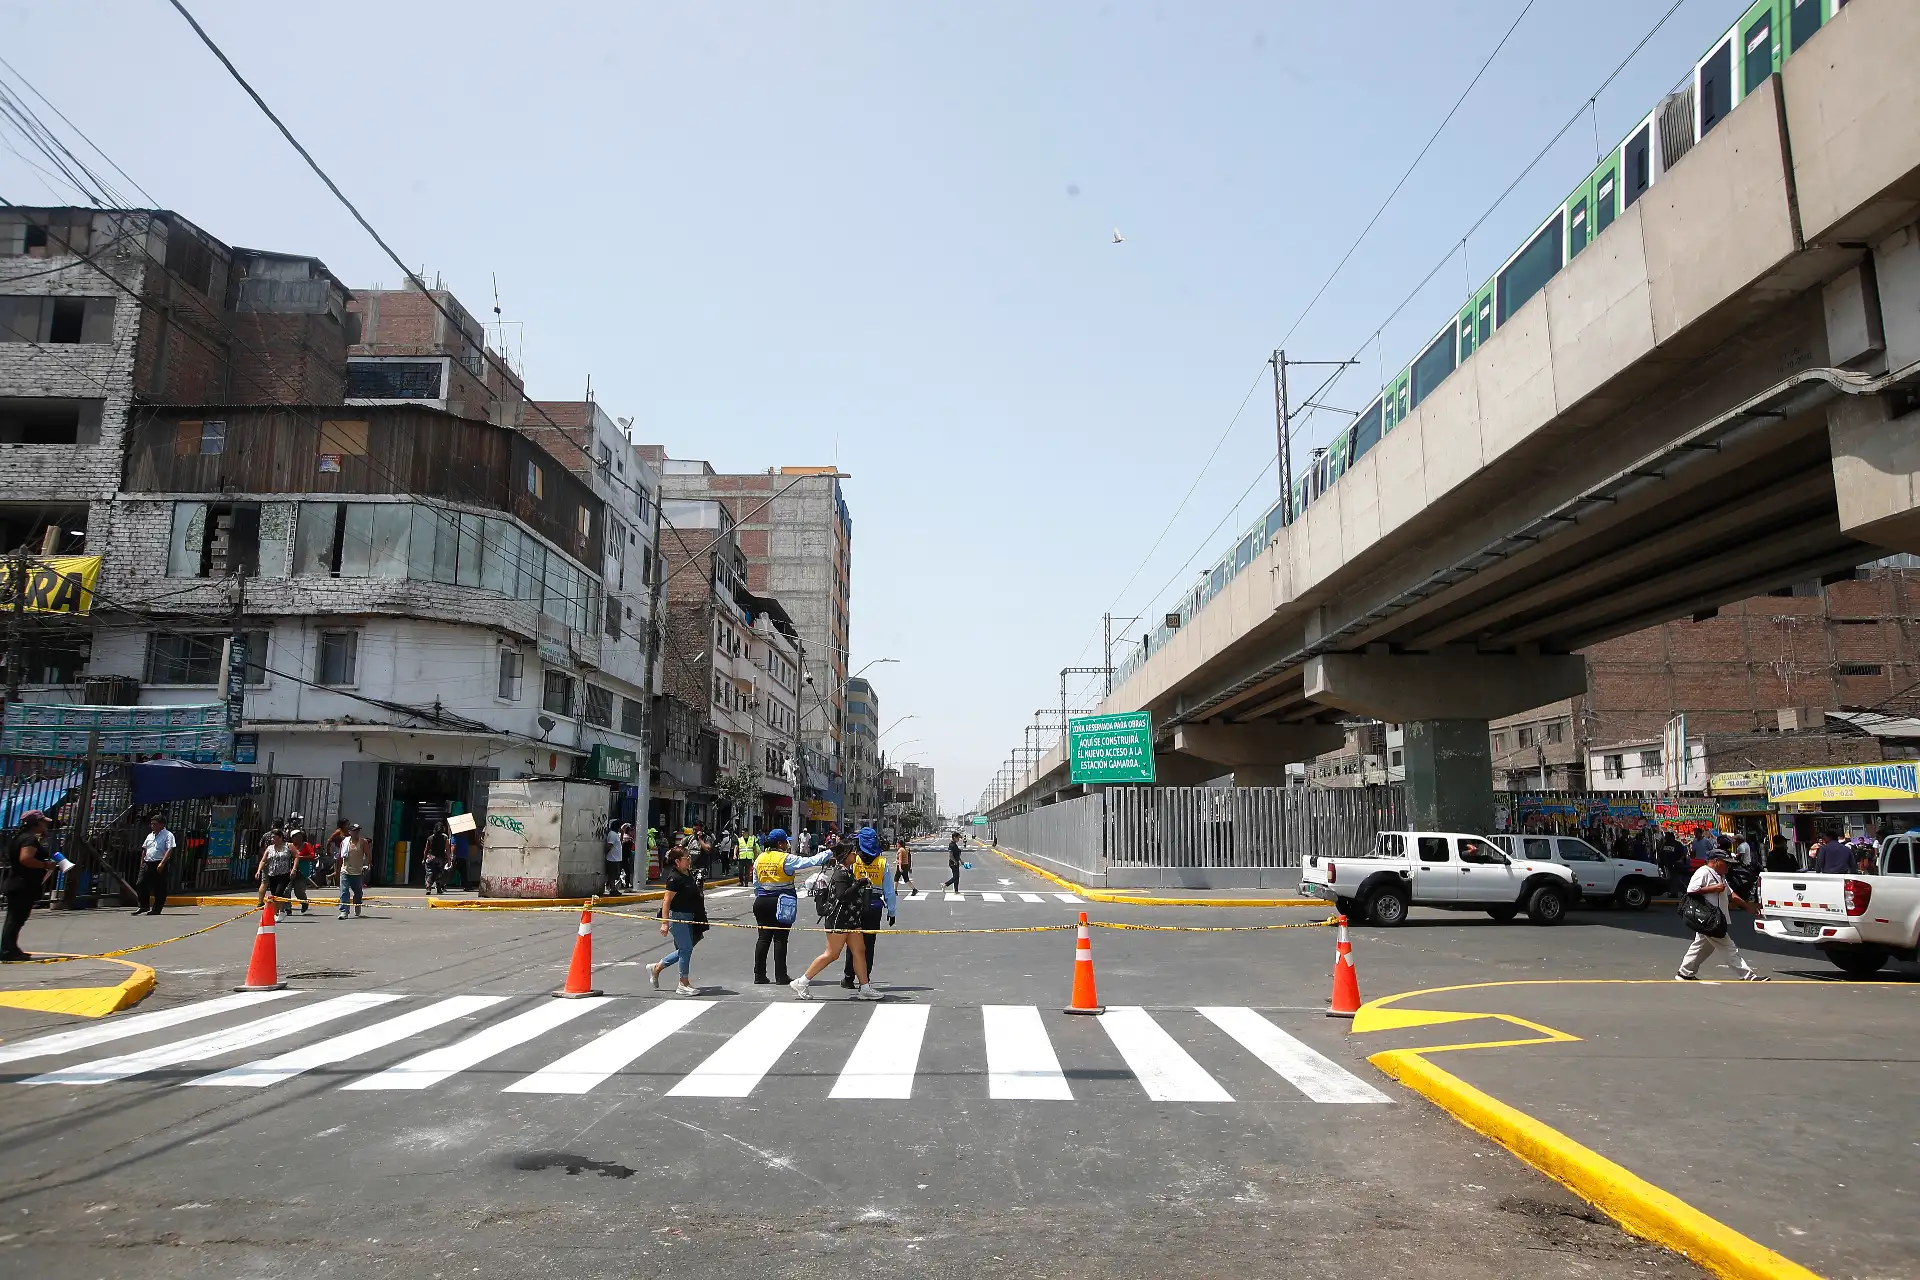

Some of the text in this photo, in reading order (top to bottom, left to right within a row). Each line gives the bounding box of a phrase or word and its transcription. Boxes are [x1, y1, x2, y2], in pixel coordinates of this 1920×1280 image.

[1072, 718, 1146, 733] ZONA RESERVADA PARA OBRAS
[1094, 737, 1101, 746] SE
[1077, 750, 1084, 758] EL
[1084, 748, 1104, 758] NUEVO
[1105, 747, 1128, 757] ACCESO
[1134, 746, 1143, 756] LA
[1769, 773, 1786, 798] C.C.
[1785, 767, 1864, 793] MULTISERVICIOS
